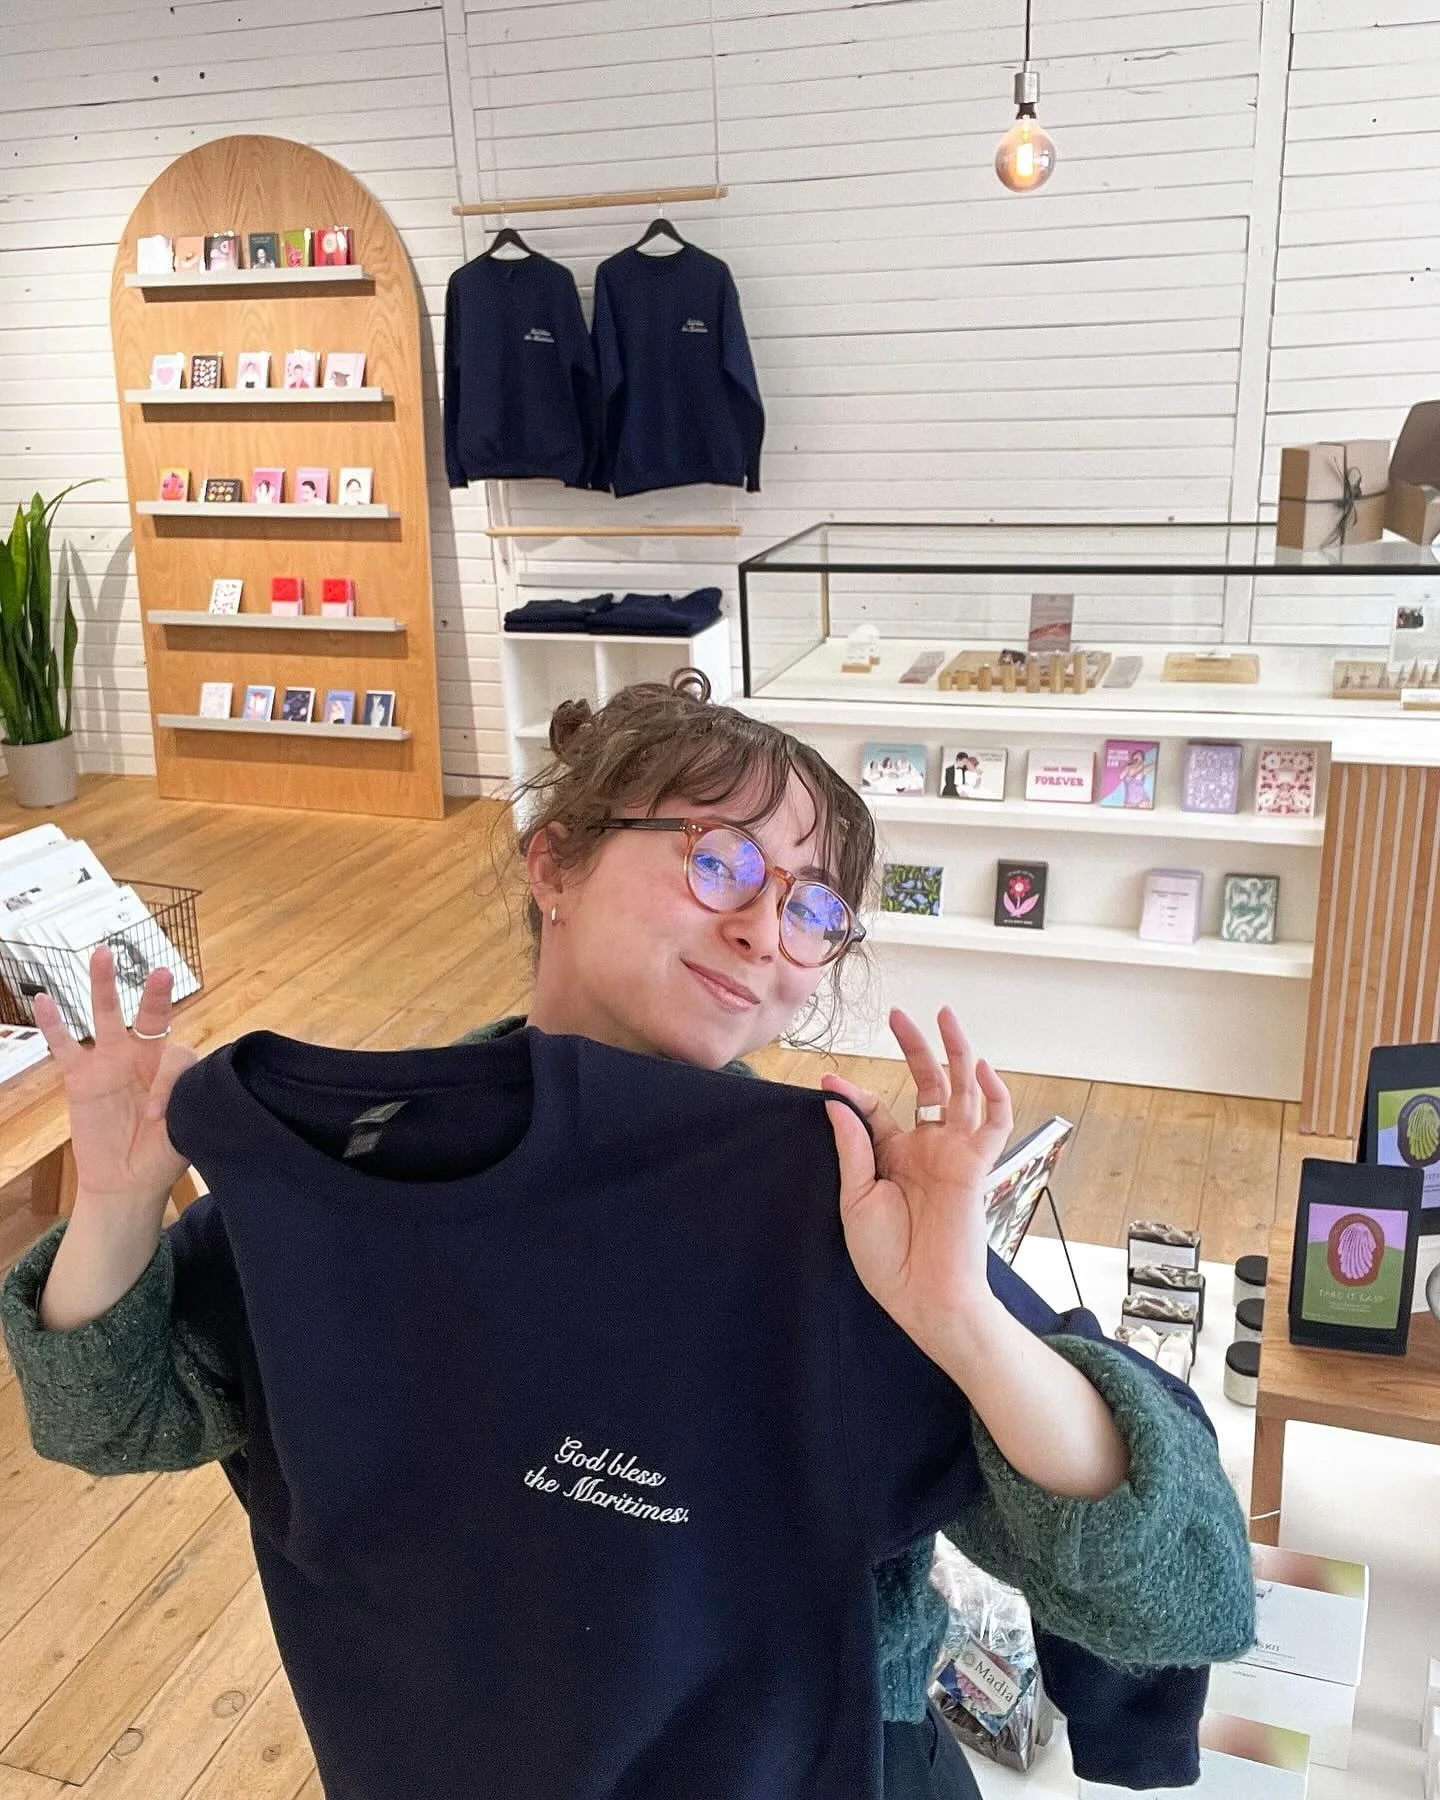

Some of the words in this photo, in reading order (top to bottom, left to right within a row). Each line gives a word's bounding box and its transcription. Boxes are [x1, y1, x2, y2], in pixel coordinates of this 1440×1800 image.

[1035, 775, 1084, 787] FOREVER
[554, 1435, 609, 1472] God
[607, 1452, 667, 1487] bless
[523, 1466, 561, 1493] the
